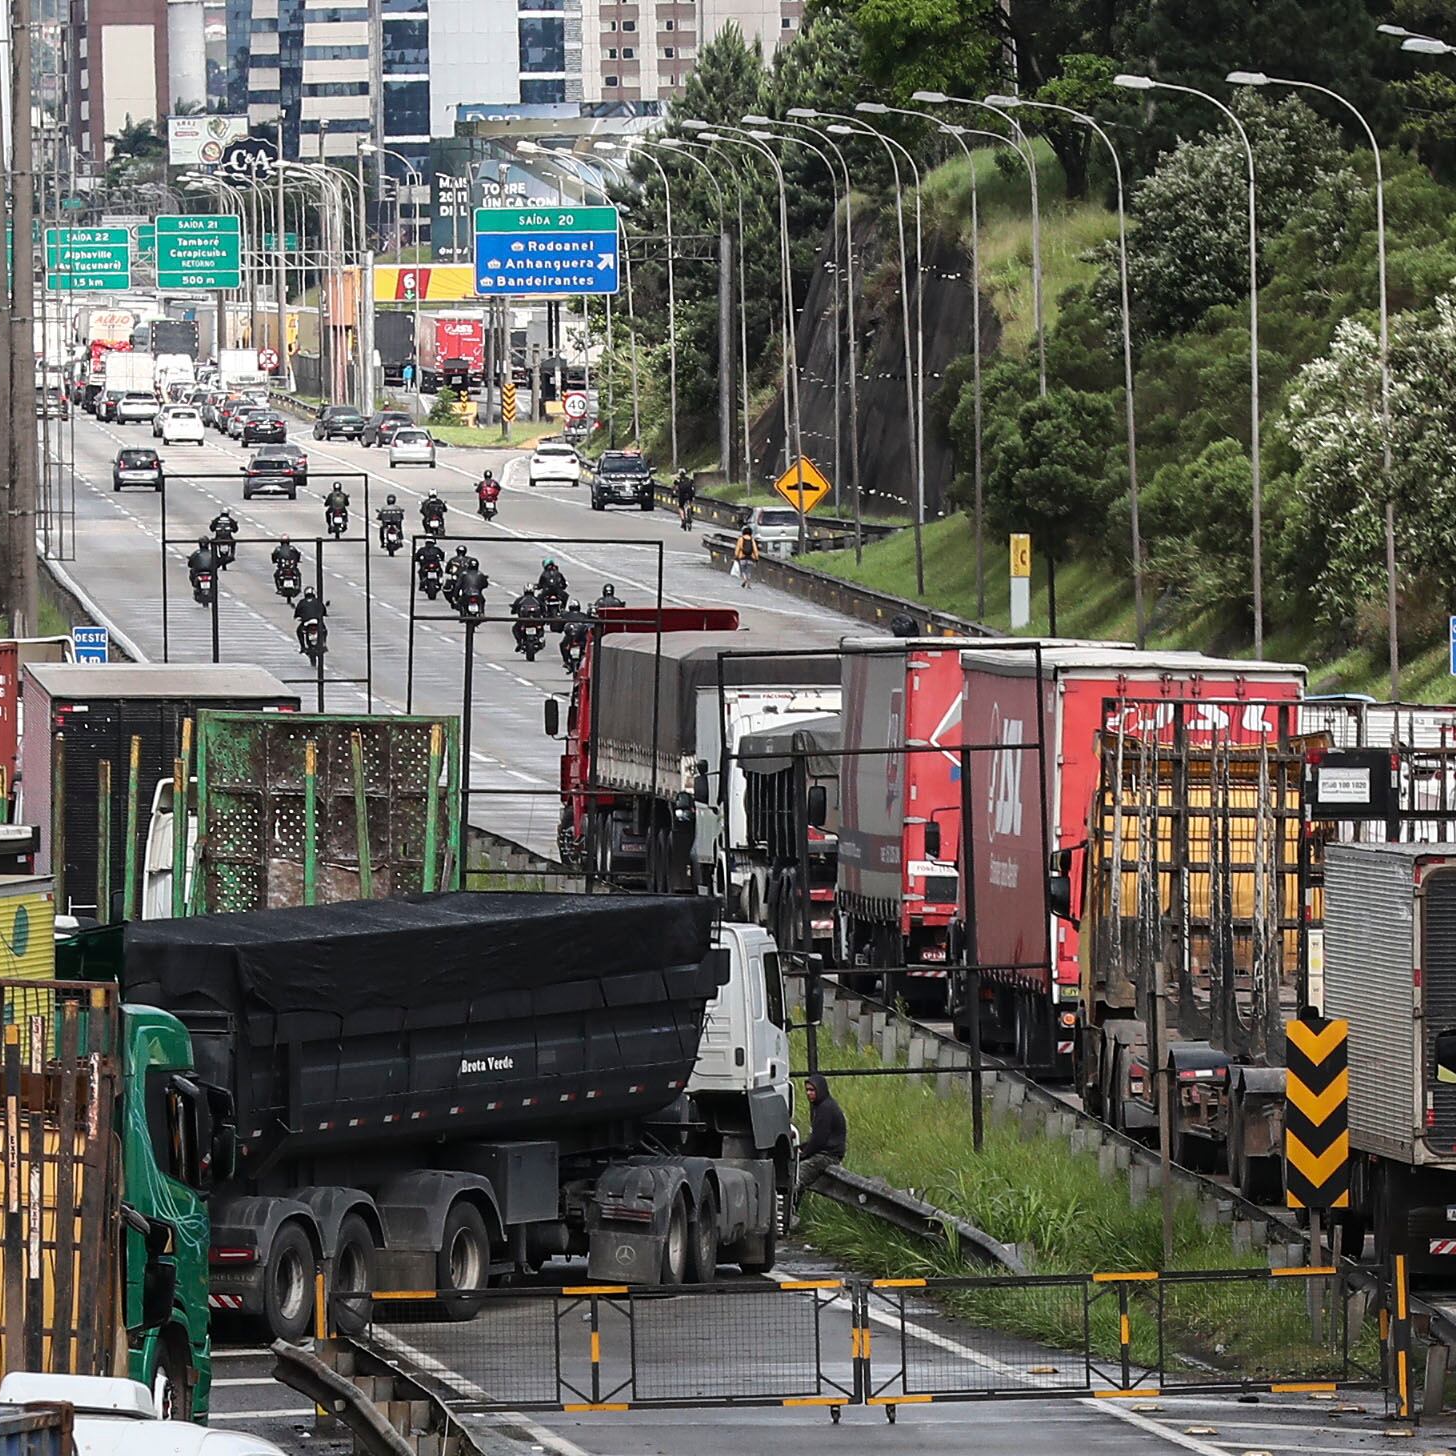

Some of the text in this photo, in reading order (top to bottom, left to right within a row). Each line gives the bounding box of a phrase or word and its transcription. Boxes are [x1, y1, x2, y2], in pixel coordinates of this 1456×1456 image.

[223, 149, 274, 171] C&A
[482, 195, 524, 208] ÚNCA
[177, 217, 218, 229] SAÍDA 21
[518, 213, 574, 226] SAÍDA 20
[95, 232, 109, 242] 22
[177, 235, 220, 247] Tamboré
[528, 241, 594, 252] Rodoanel
[64, 251, 112, 261] Alphaville
[181, 260, 215, 268] RETORNO
[505, 258, 594, 272] Anhanguera
[88, 278, 104, 287] km
[182, 275, 215, 285] 500 m
[403, 272, 416, 290] 6
[496, 275, 594, 287] Bandeirantes
[567, 400, 586, 411] 40
[75, 633, 106, 643] OESTE
[461, 1055, 514, 1073] Brota Verde
